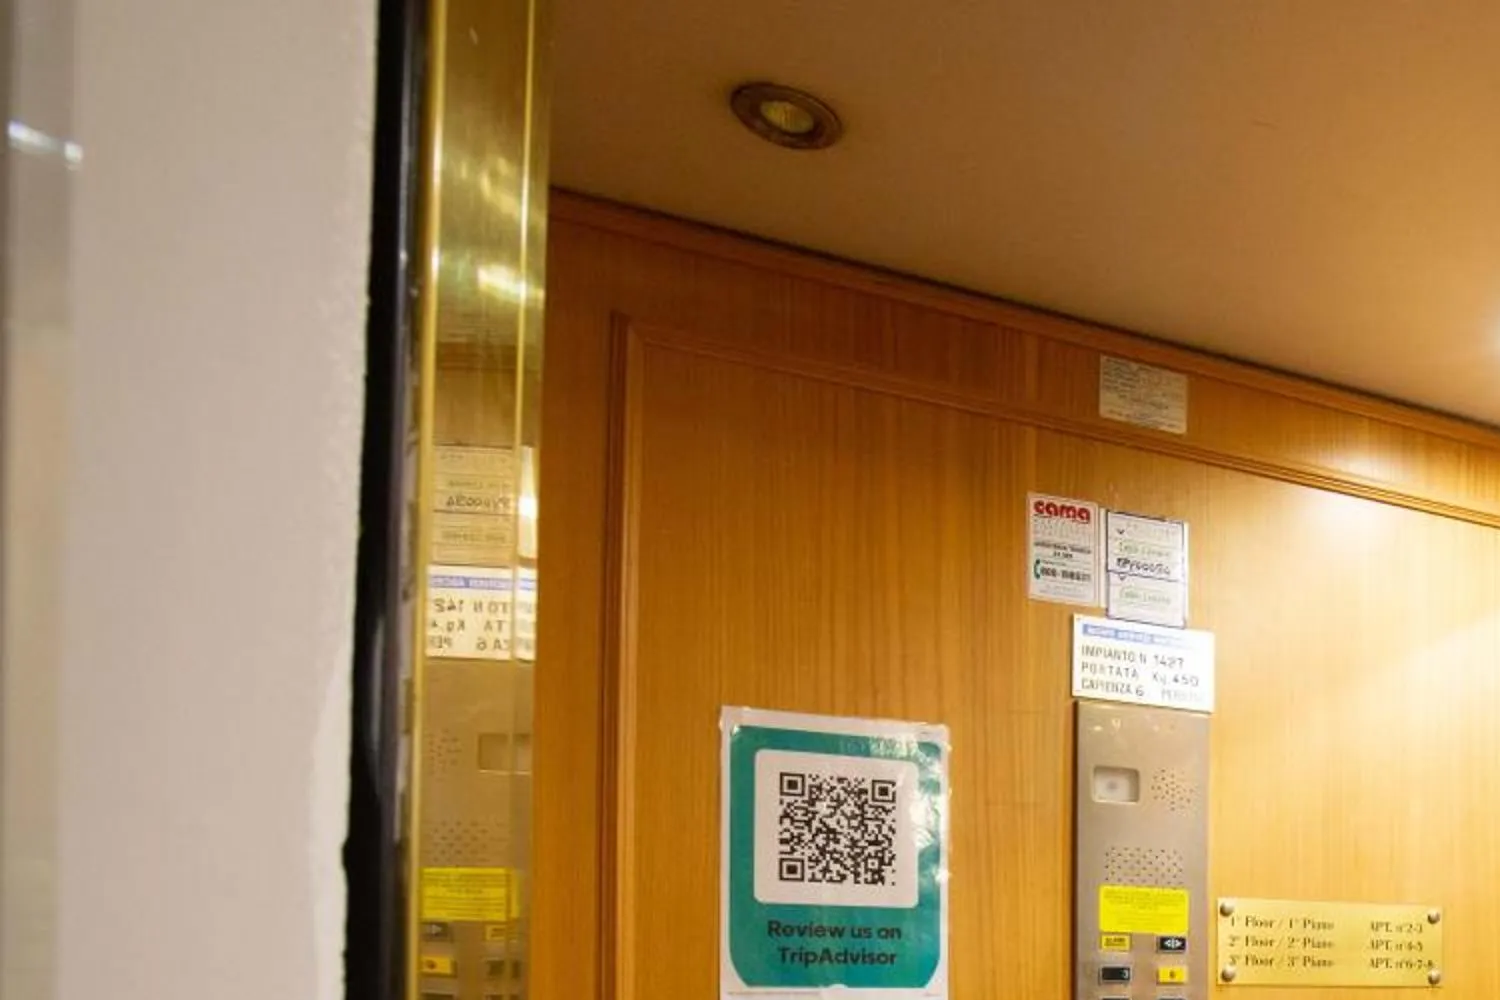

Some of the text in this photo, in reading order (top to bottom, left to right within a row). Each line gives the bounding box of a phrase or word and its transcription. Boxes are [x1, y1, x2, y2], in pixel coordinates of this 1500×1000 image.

[1081, 644, 1135, 662] IMPIANTO
[1081, 661, 1139, 680] PORTATA
[1081, 678, 1133, 695] CAPIENZA
[1135, 685, 1145, 697] 6
[767, 920, 902, 940] Review us on
[1245, 916, 1275, 928] Floor
[1303, 918, 1334, 931] Piano
[1245, 936, 1275, 948] Floor
[1303, 938, 1334, 949] Piano
[778, 947, 897, 968] TripAdvisor
[1245, 955, 1275, 967] Floor
[1303, 957, 1334, 967] Piano
